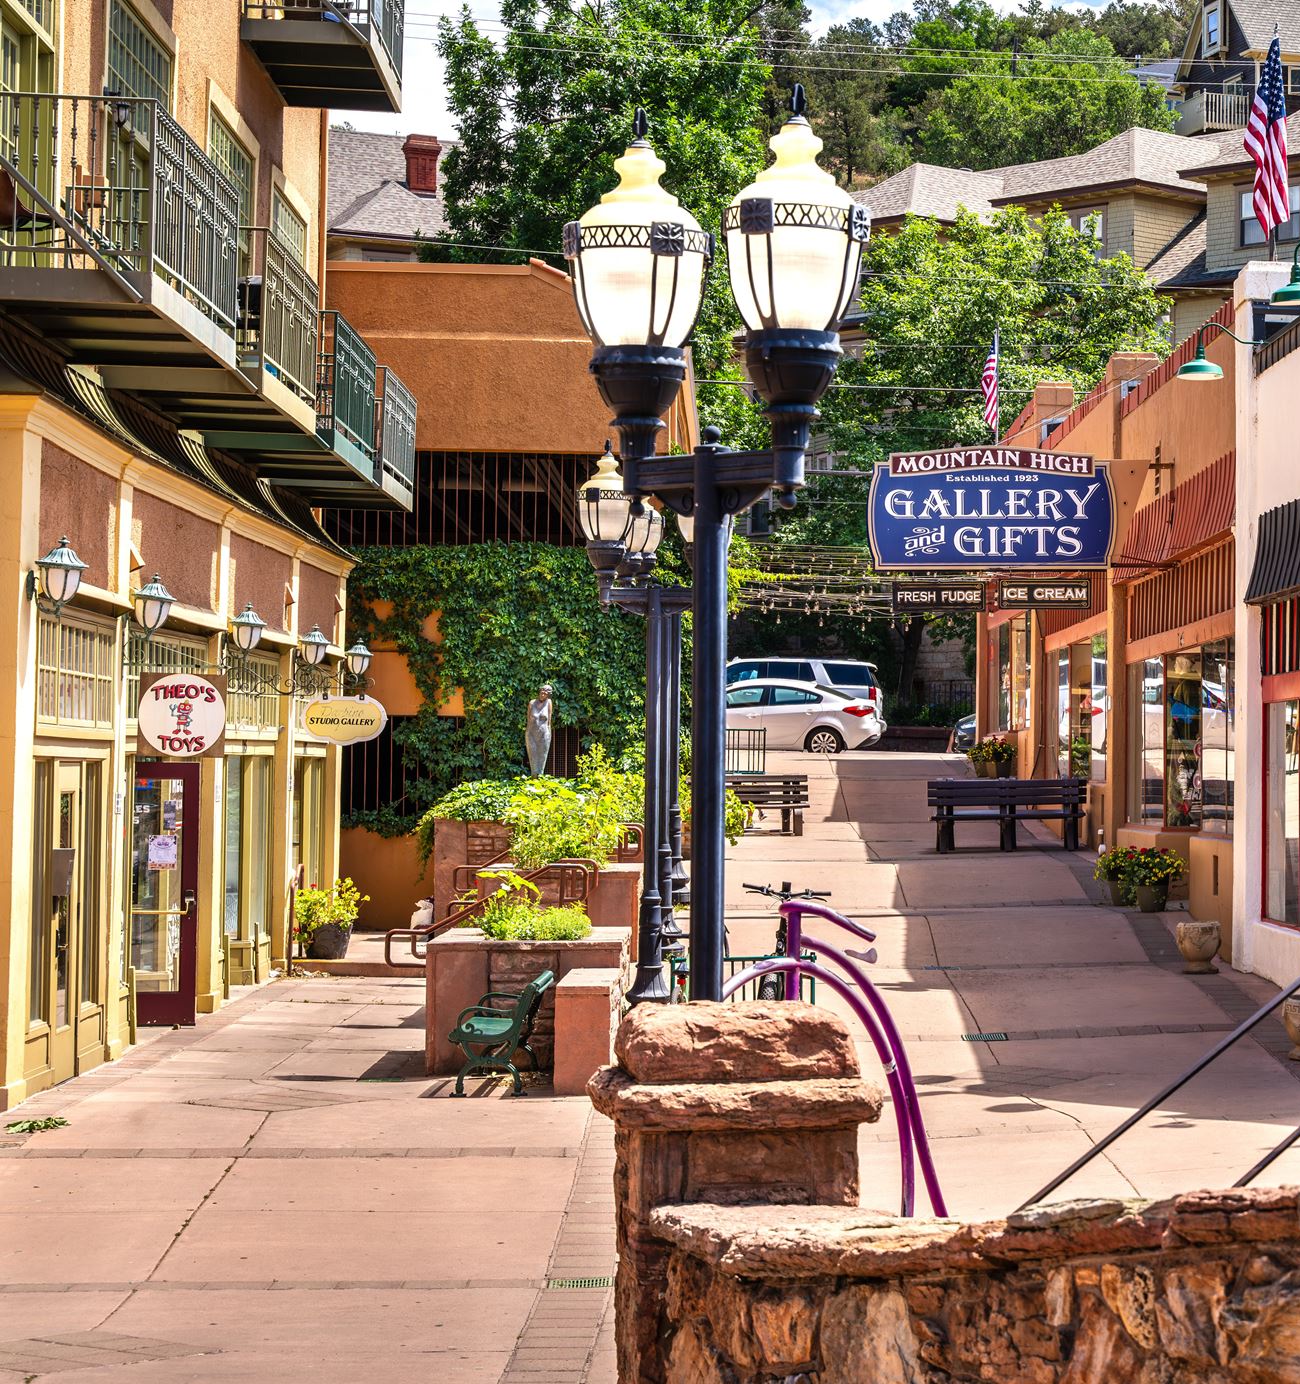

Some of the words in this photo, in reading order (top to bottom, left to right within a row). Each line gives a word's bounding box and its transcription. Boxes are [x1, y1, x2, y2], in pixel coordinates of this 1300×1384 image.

[896, 450, 1020, 473] MOUNTAIN
[1031, 453, 1089, 473] HIGH
[946, 474, 1010, 482] Established
[1014, 474, 1039, 482] 1923
[884, 482, 1101, 521] GALLERY
[904, 525, 946, 554] and
[953, 526, 1083, 556] GIFTS
[897, 591, 936, 601] FRESH
[941, 590, 981, 601] FUDGE
[1003, 588, 1028, 599] ICE
[1034, 587, 1087, 599] CREAM
[151, 683, 216, 703] THEO'S
[309, 717, 339, 725] STUDIO
[341, 718, 375, 726] GALLERY
[157, 734, 206, 752] TOYS
